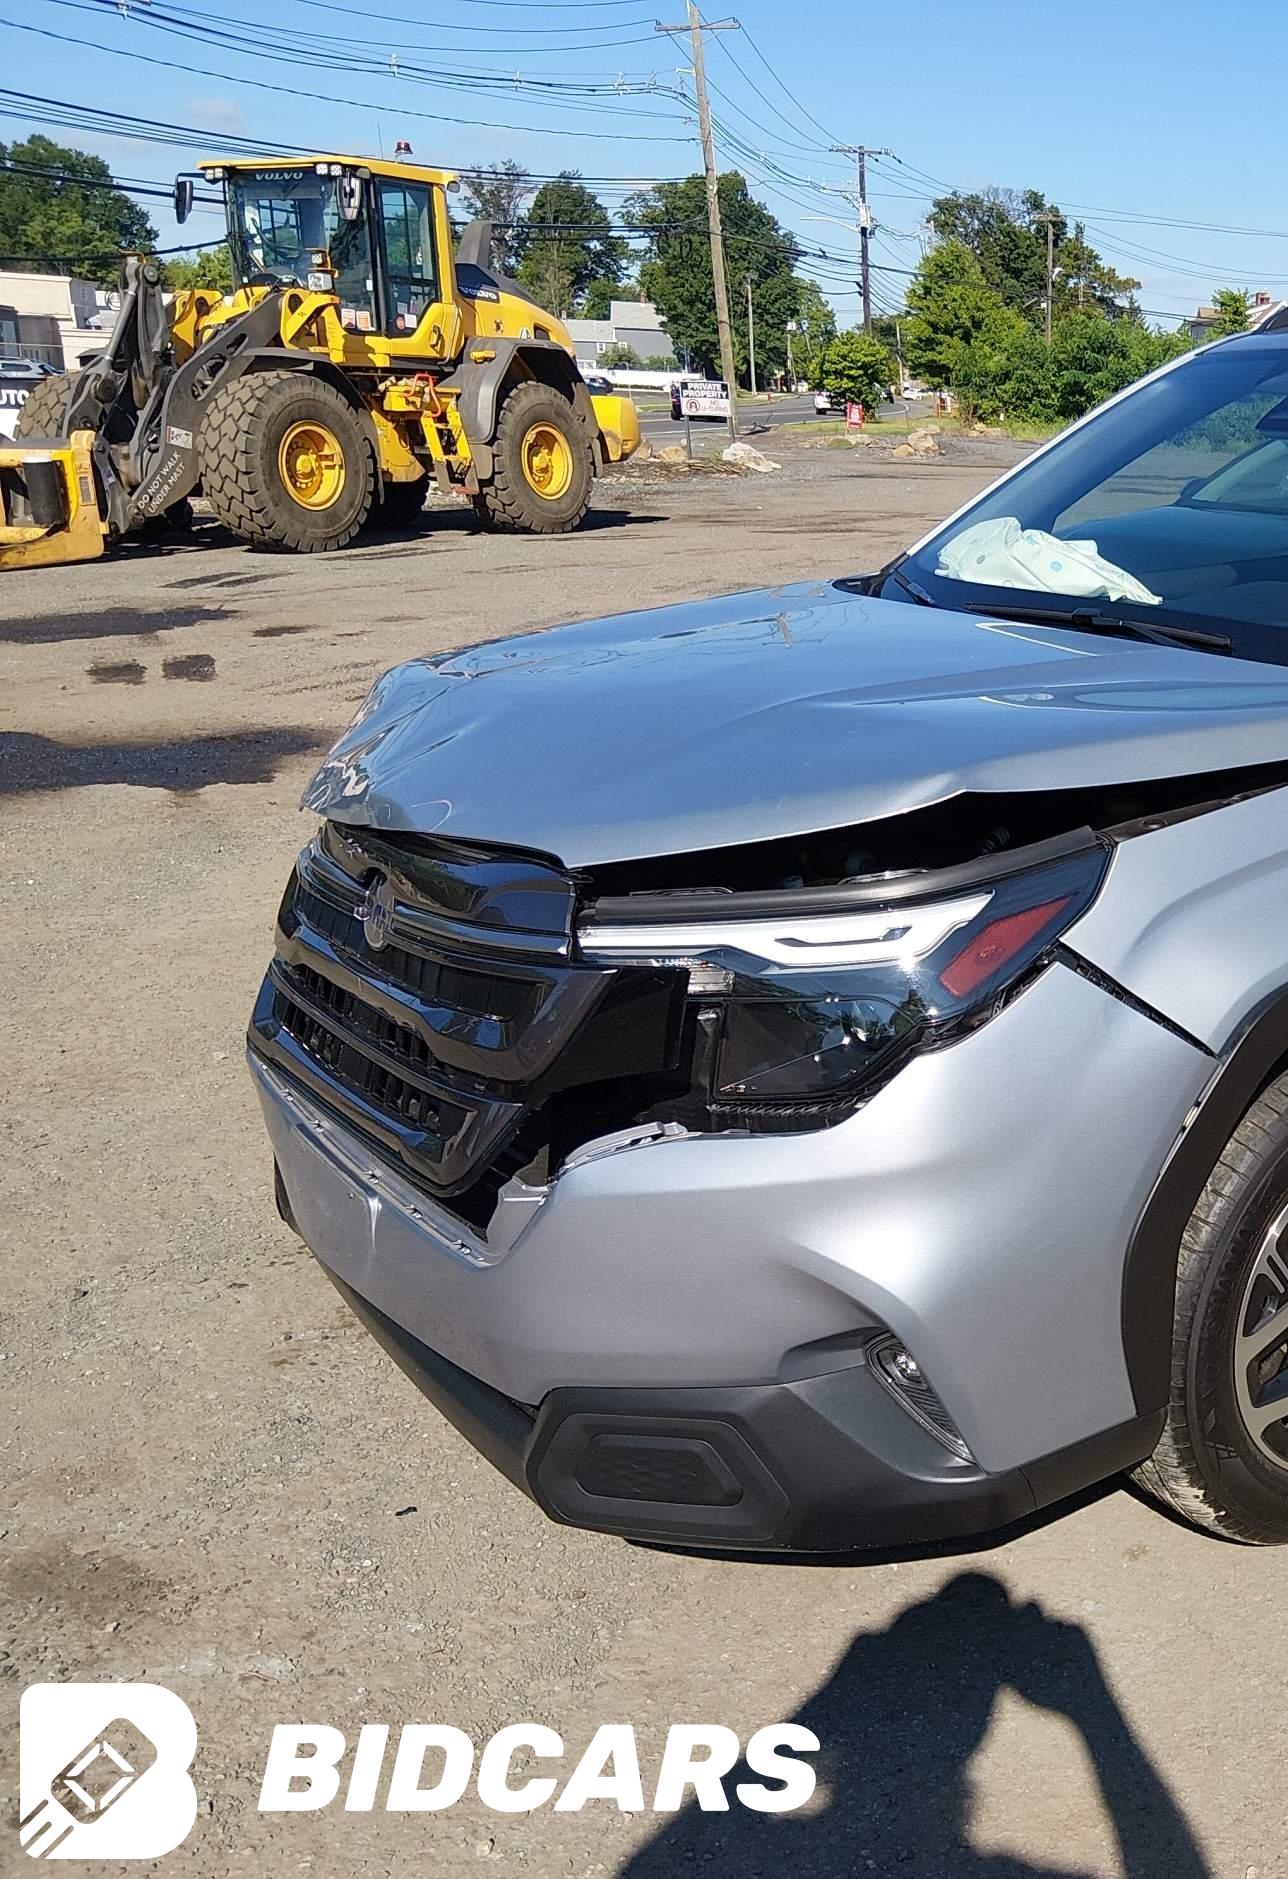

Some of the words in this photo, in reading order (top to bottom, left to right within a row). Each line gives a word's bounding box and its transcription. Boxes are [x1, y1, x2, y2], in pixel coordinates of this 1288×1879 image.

[255, 171, 303, 181] VOLVO
[458, 286, 498, 300] VOLVO
[687, 382, 722, 391] PRIVATE
[682, 390, 728, 399] PROPERTY
[137, 494, 149, 509] DO
[147, 474, 163, 496] NOT
[160, 450, 181, 475] WALK
[148, 484, 171, 513] UNDER
[167, 461, 185, 486] MAST
